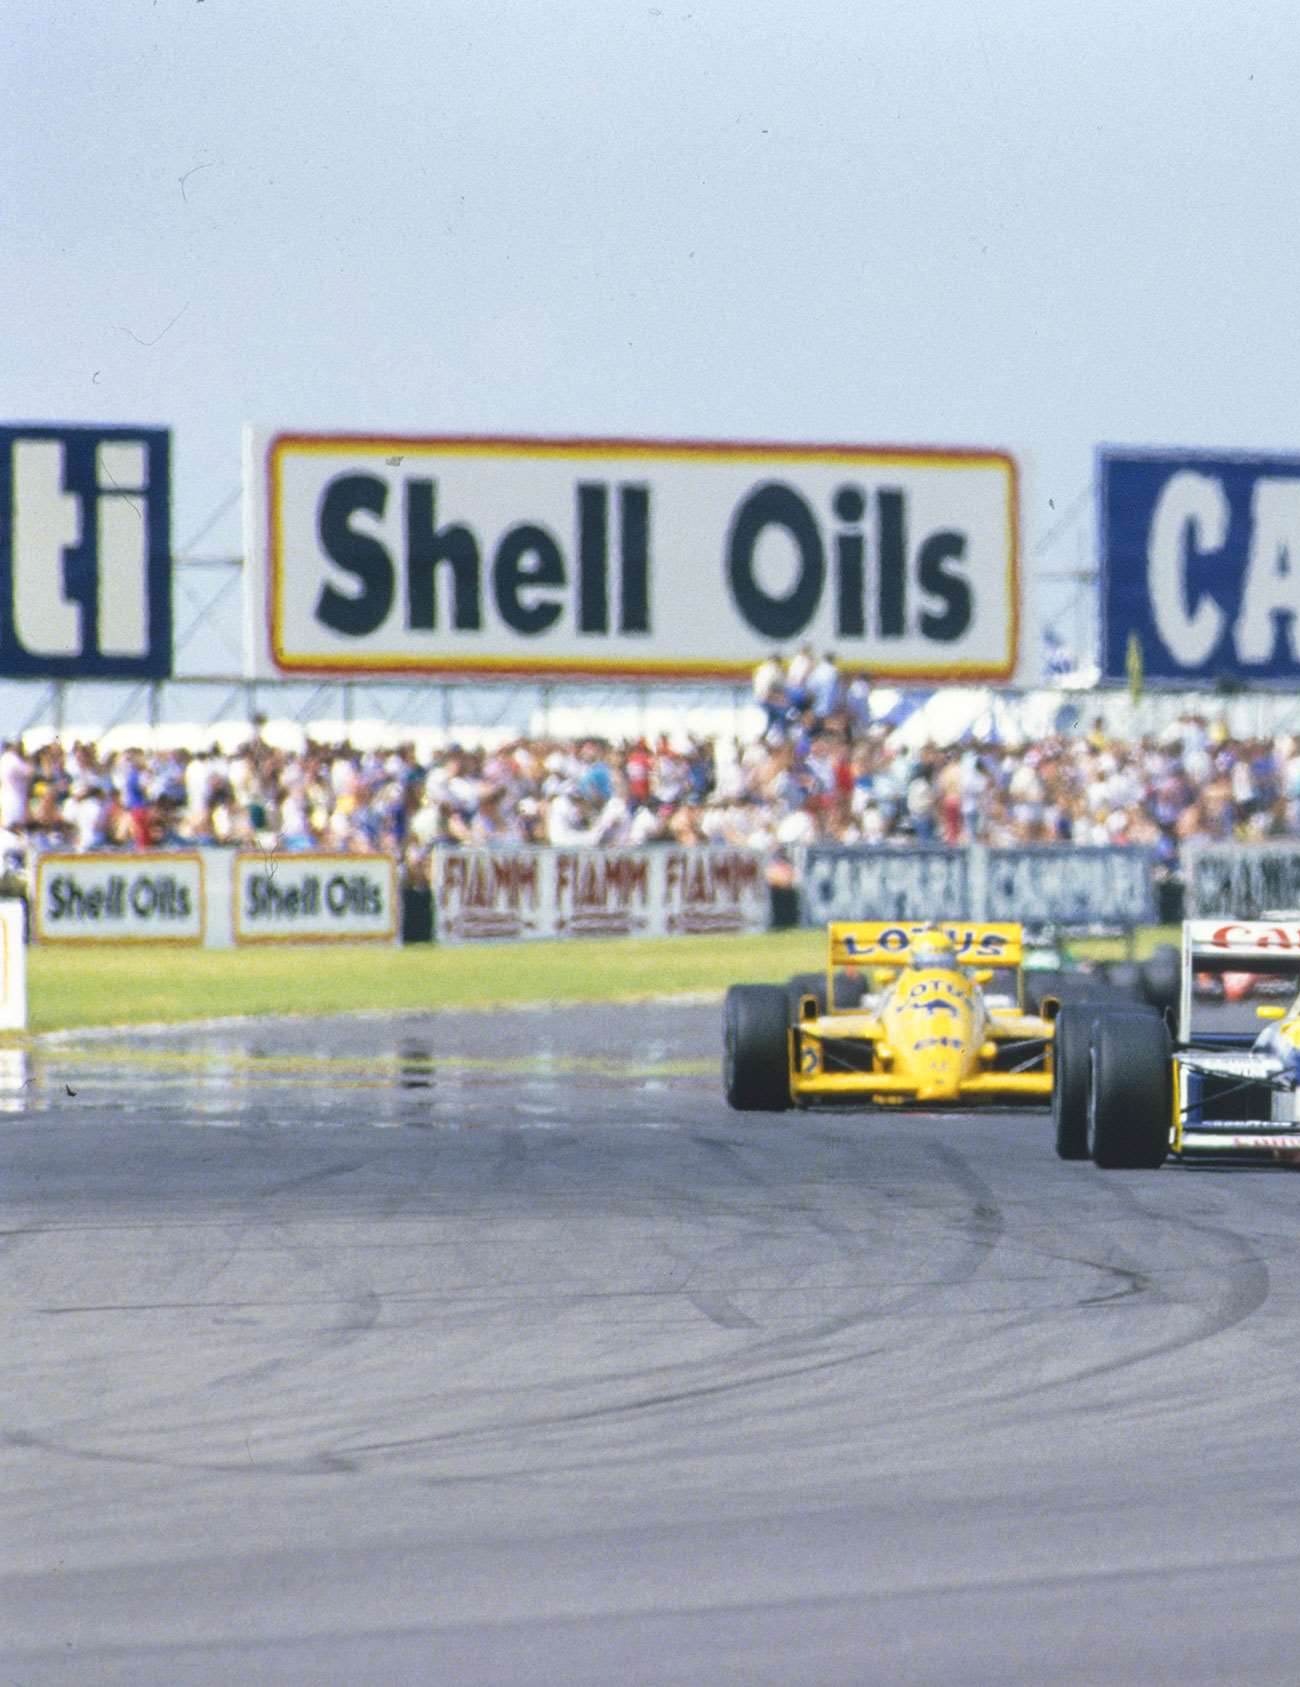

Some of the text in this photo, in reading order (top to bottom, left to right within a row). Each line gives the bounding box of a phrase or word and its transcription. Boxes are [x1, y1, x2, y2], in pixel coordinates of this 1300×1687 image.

[314, 471, 974, 643] Shell Oils
[49, 874, 193, 921] Shell Oils
[246, 874, 383, 918] Shell Oils
[441, 855, 539, 909] FIAMM
[555, 854, 650, 907] FIAMM
